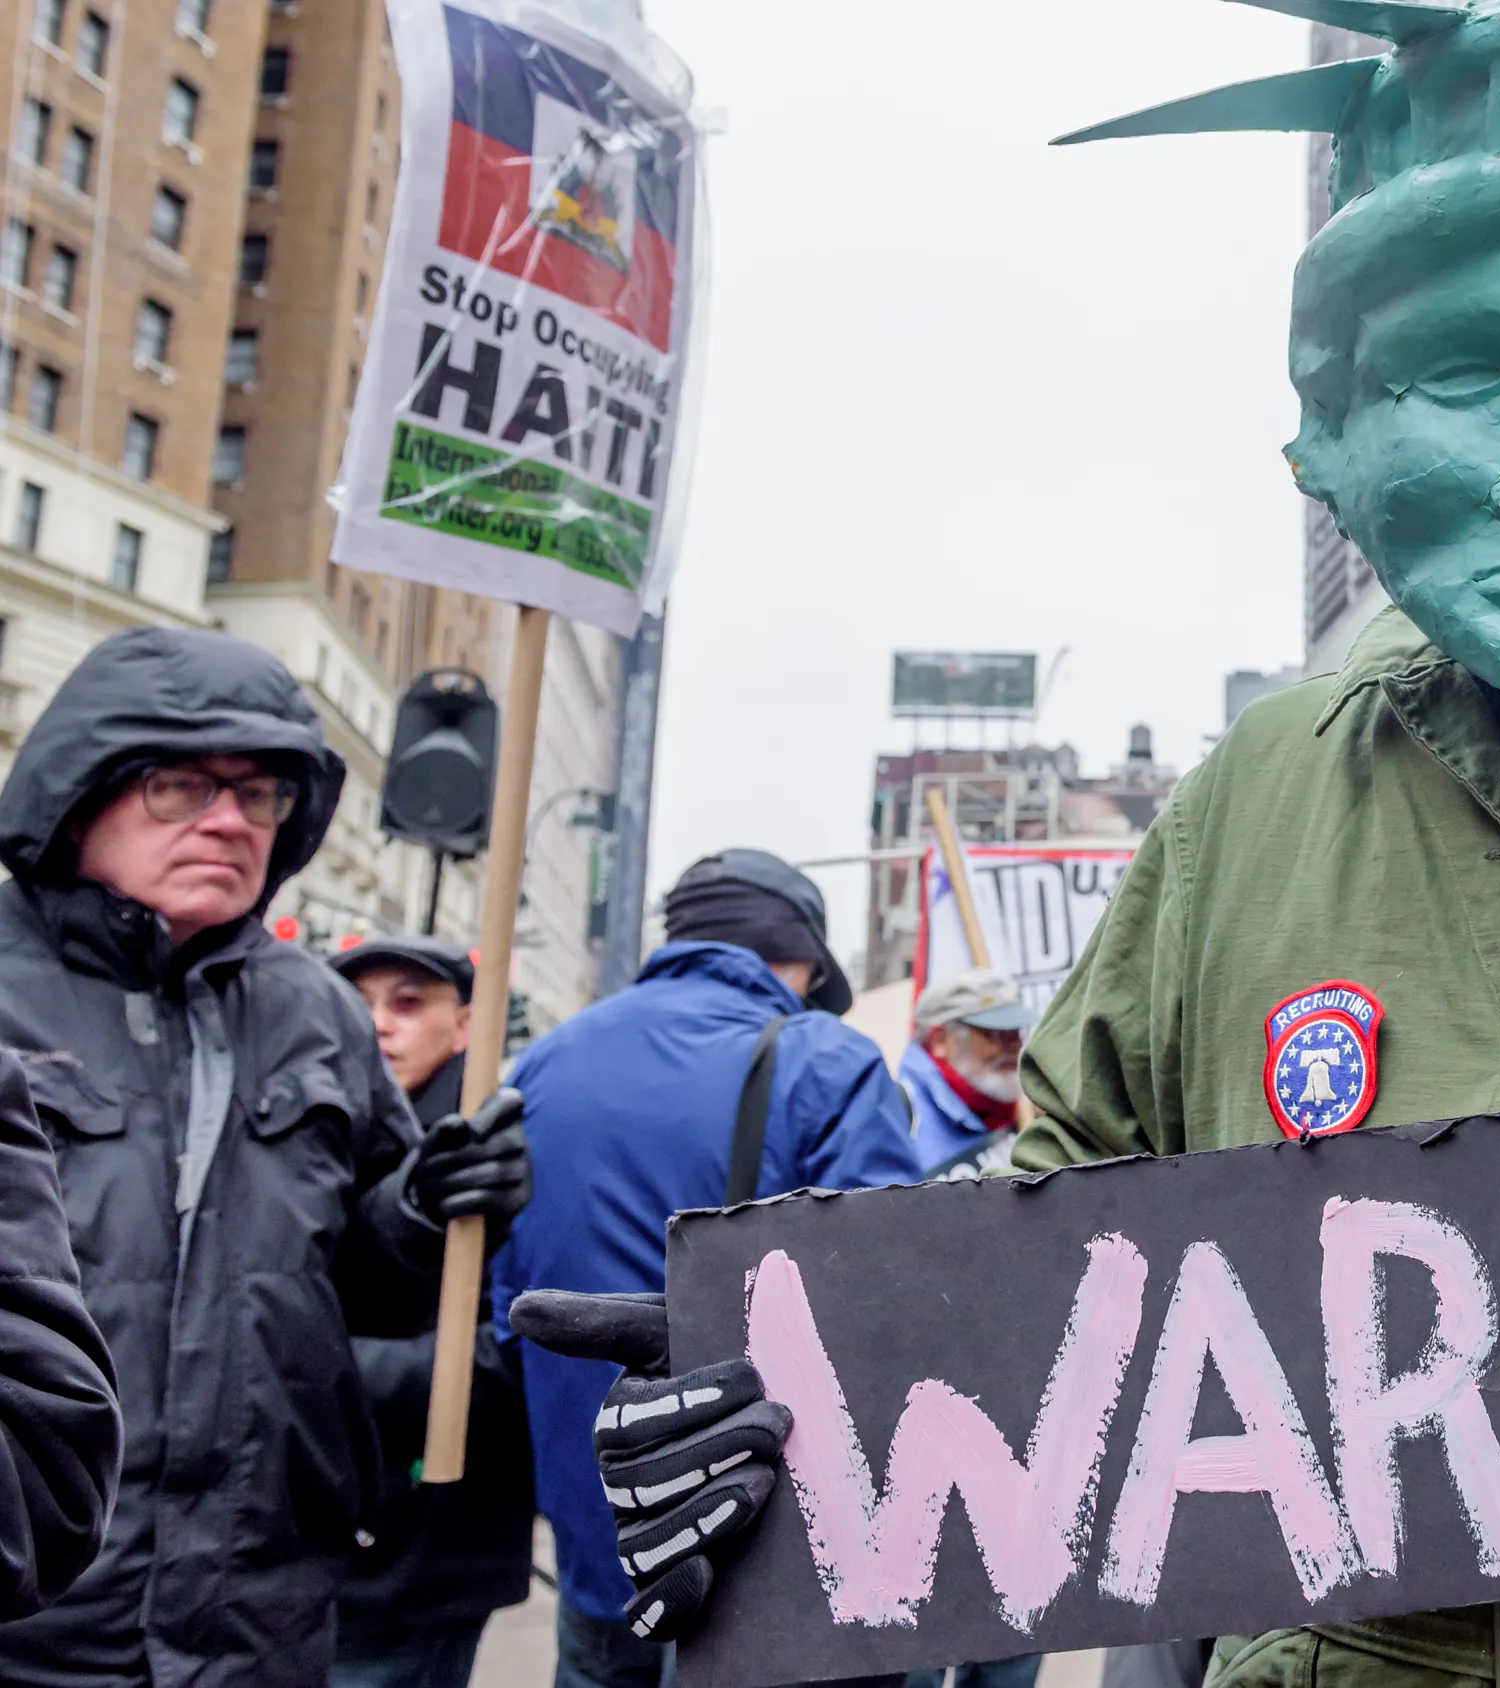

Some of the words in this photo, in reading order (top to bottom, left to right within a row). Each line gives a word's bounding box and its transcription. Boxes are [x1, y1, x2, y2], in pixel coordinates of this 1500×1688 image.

[419, 264, 520, 335] Stop
[408, 322, 662, 499] HAITI
[1275, 989, 1373, 1033] RECRUITING
